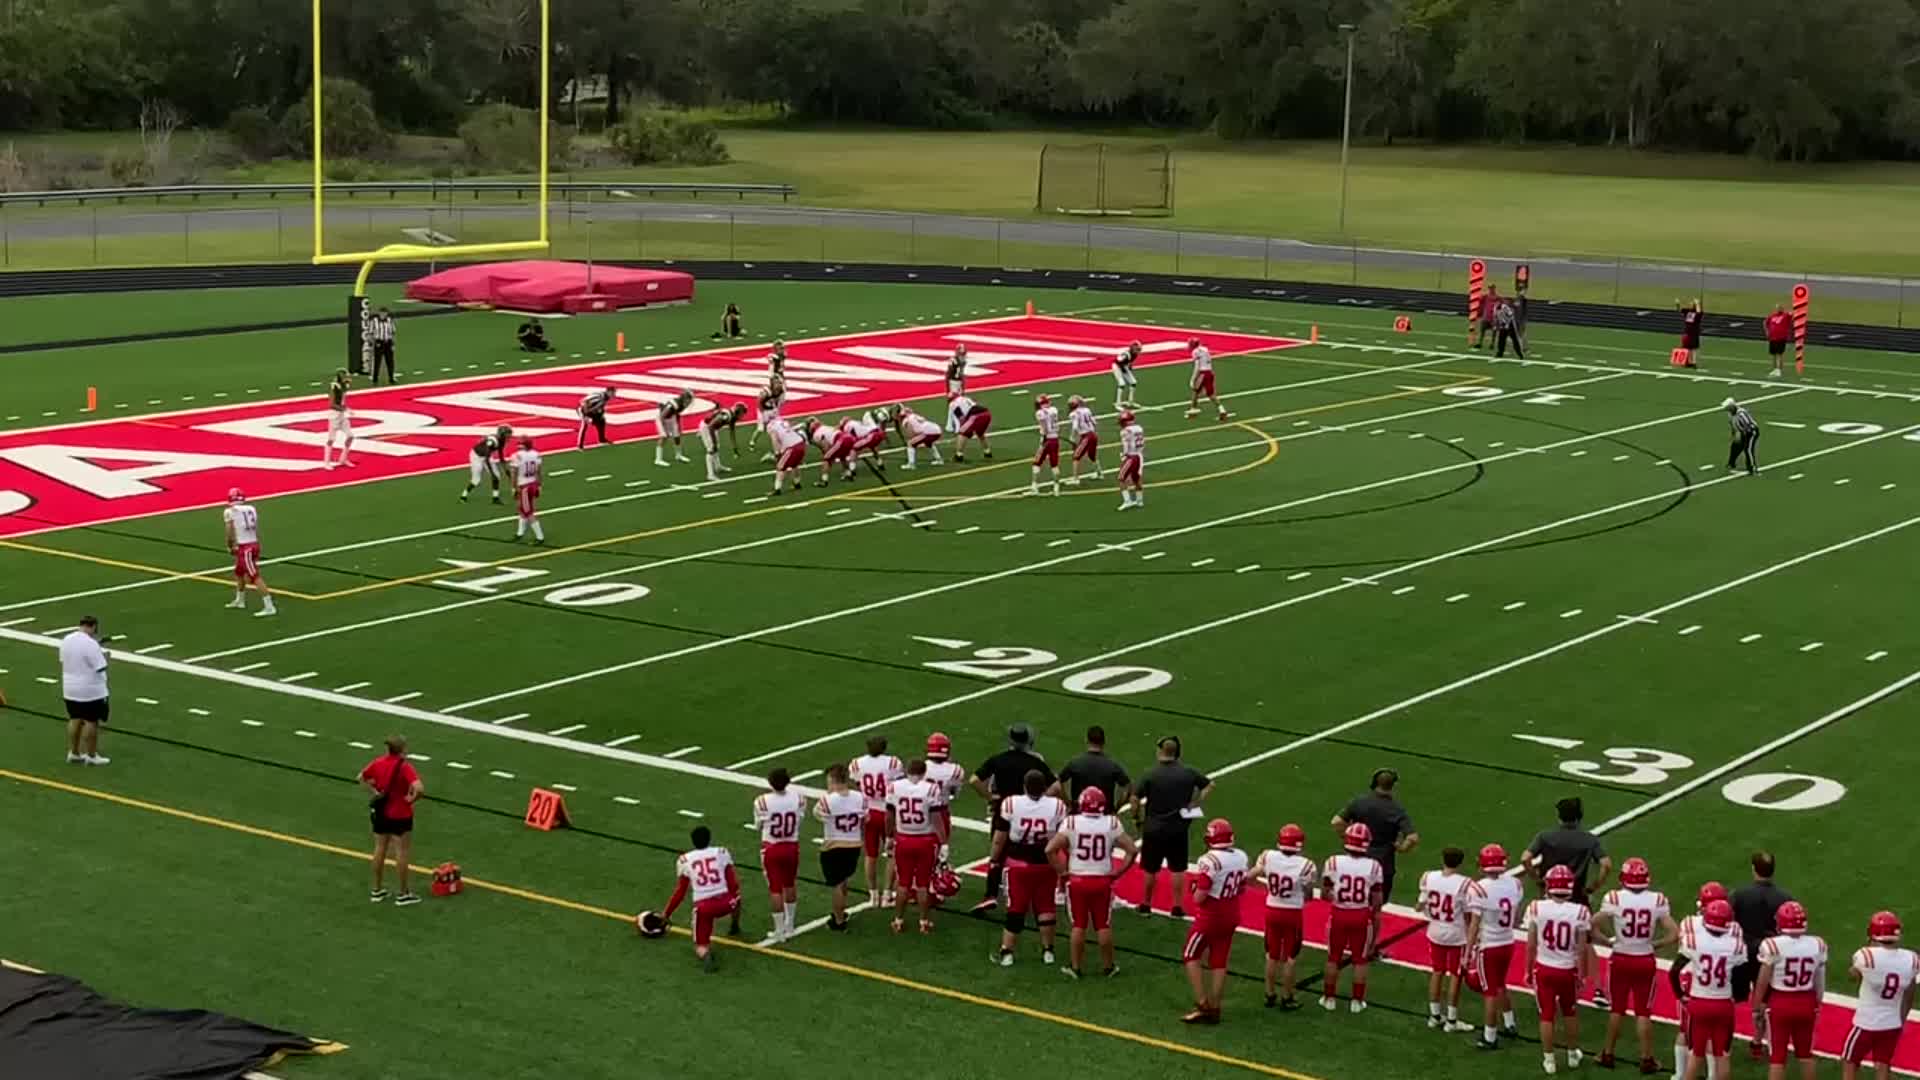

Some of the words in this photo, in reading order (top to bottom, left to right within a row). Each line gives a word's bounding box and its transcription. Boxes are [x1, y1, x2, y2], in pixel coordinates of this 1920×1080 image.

[0, 332, 1190, 516] ARDINAL
[524, 460, 537, 478] 10
[242, 509, 257, 531] 13
[863, 773, 886, 798] 84
[528, 792, 553, 825] 20
[834, 813, 858, 833] 52
[898, 796, 924, 825] 25
[770, 811, 796, 838] 20
[1020, 818, 1048, 845] 72
[1076, 833, 1106, 862] 50
[692, 857, 721, 886] 35
[1267, 873, 1293, 899] 82
[1337, 875, 1366, 903] 28
[1428, 890, 1455, 923] 24
[1498, 897, 1512, 928] 3
[1542, 919, 1571, 951] 40
[1621, 908, 1652, 939] 32
[1699, 953, 1729, 988] 34
[1783, 956, 1815, 988] 56
[1882, 972, 1900, 1000] 8
